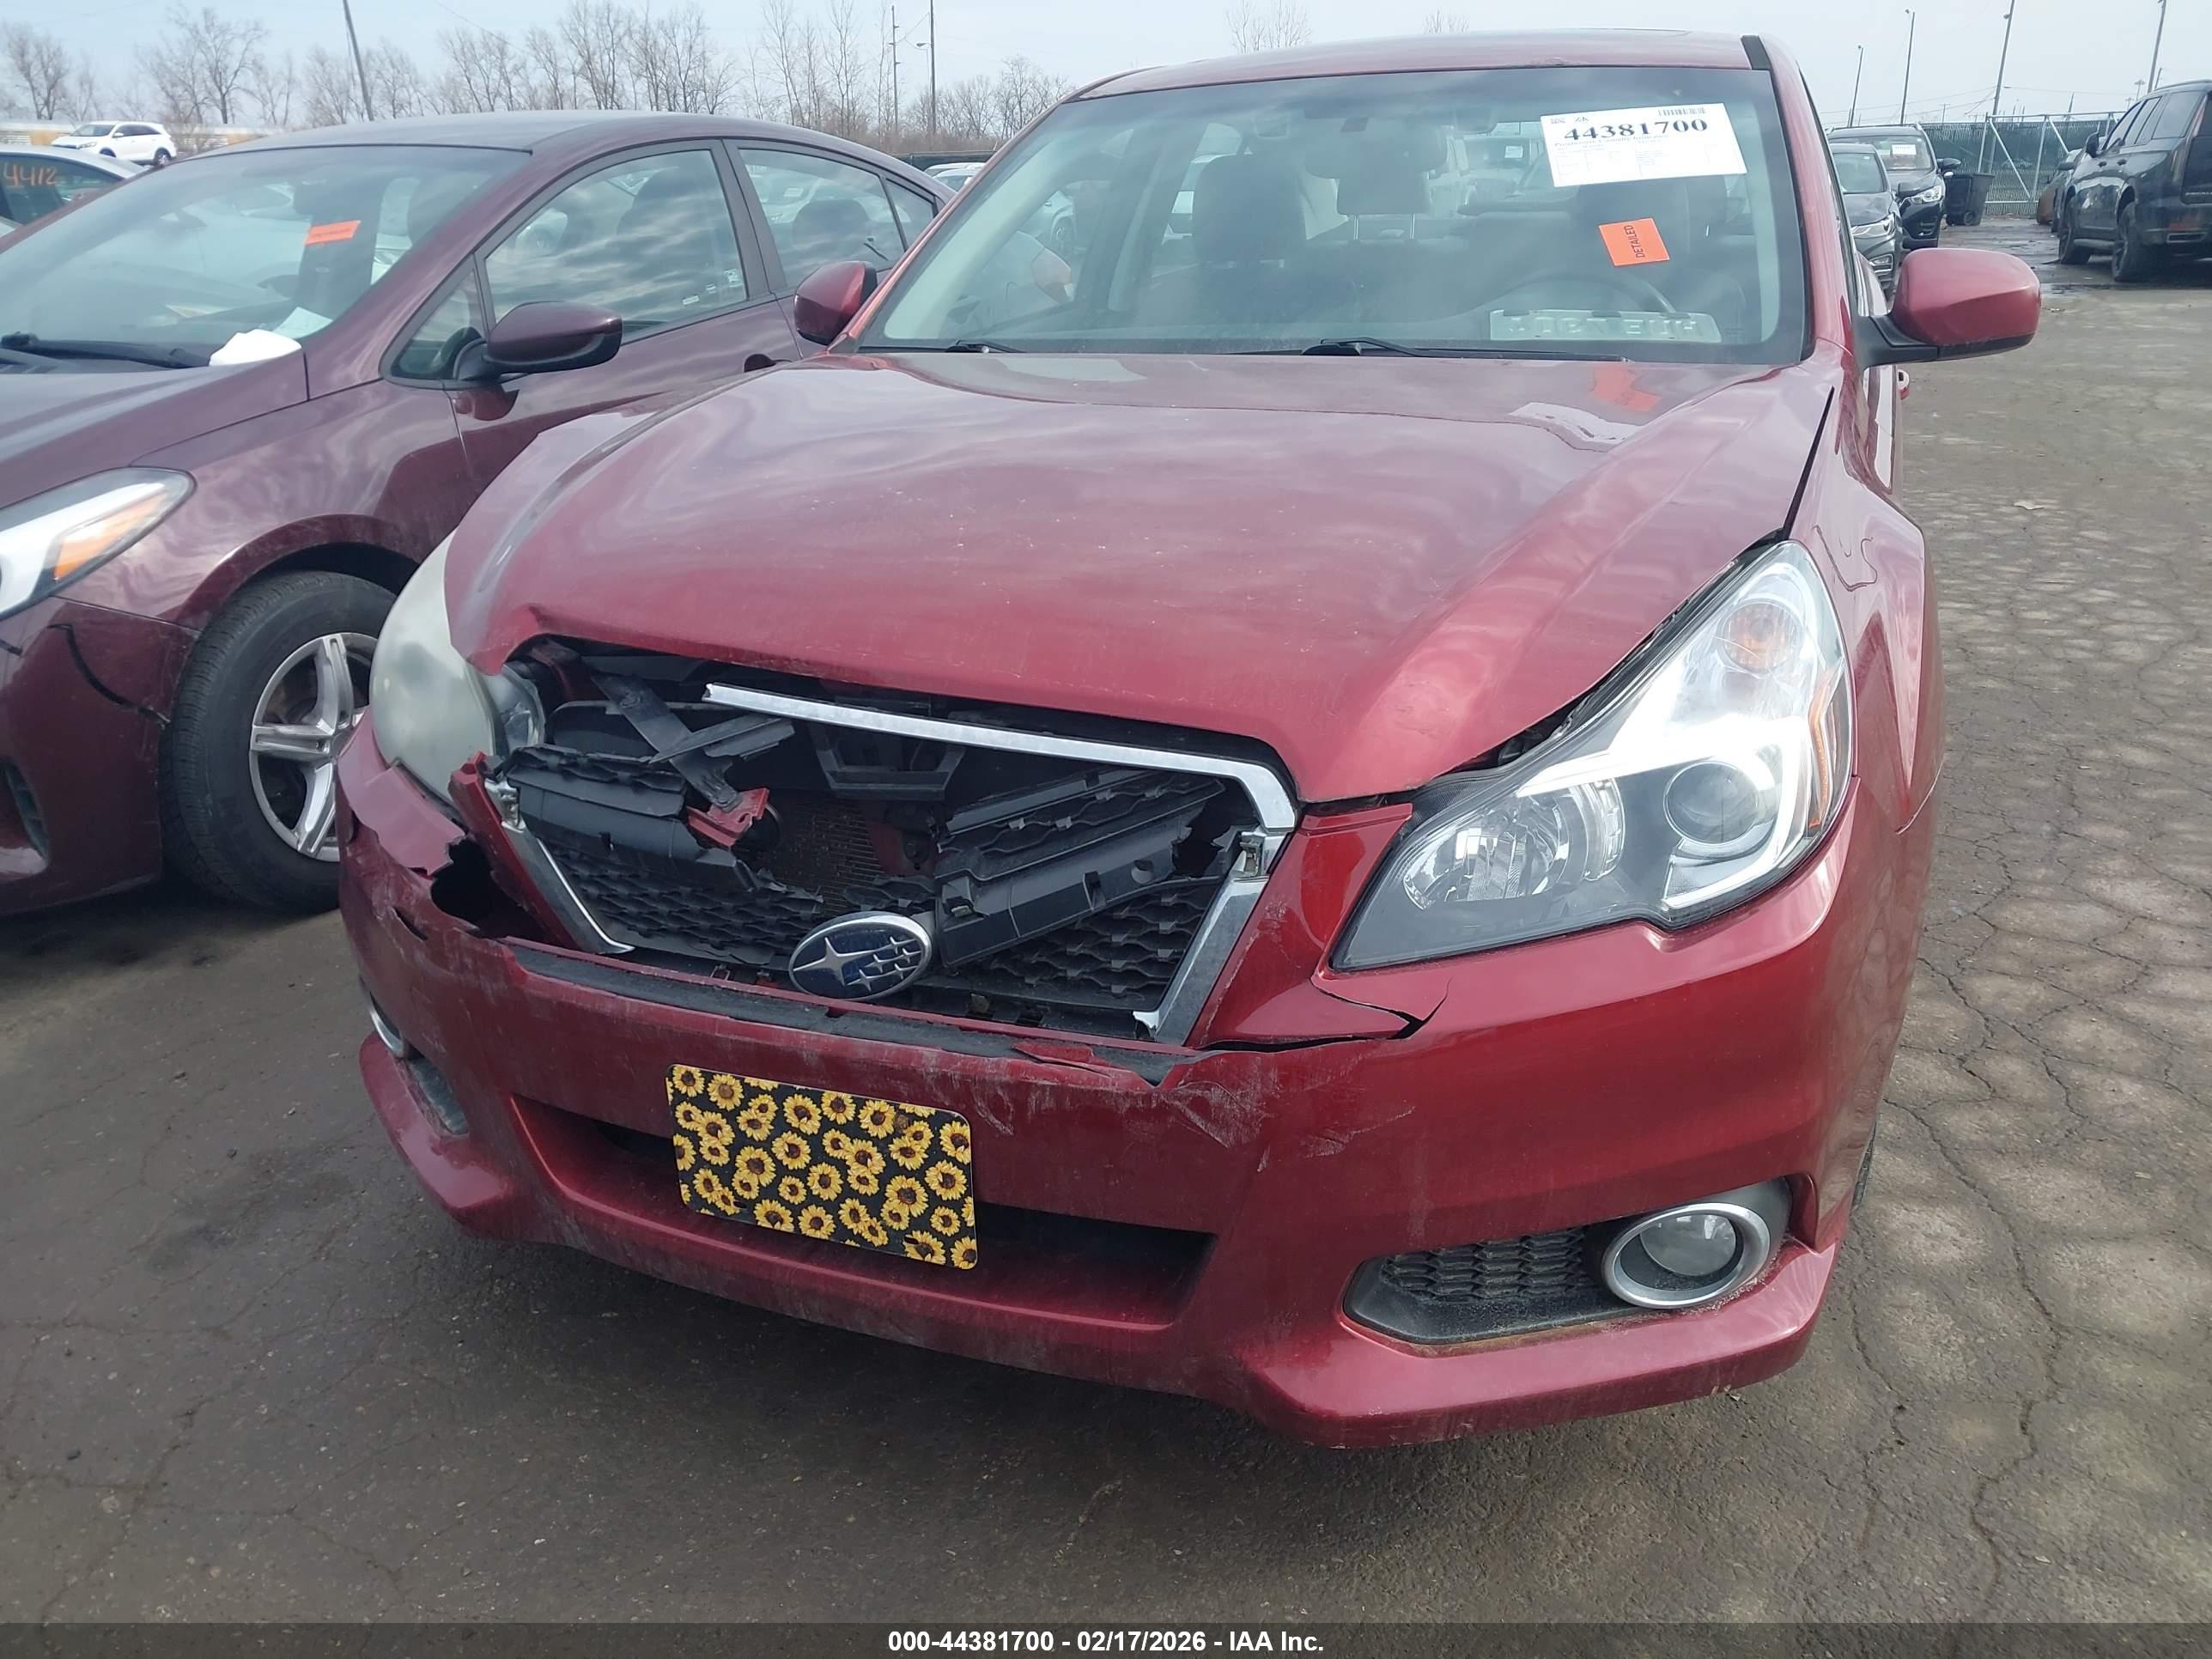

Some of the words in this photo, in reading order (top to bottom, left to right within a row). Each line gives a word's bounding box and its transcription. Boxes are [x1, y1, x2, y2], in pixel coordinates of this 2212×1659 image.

[1564, 118, 1708, 140] 44381700
[3, 162, 57, 186] 4412
[1624, 225, 1646, 258] DETAILED
